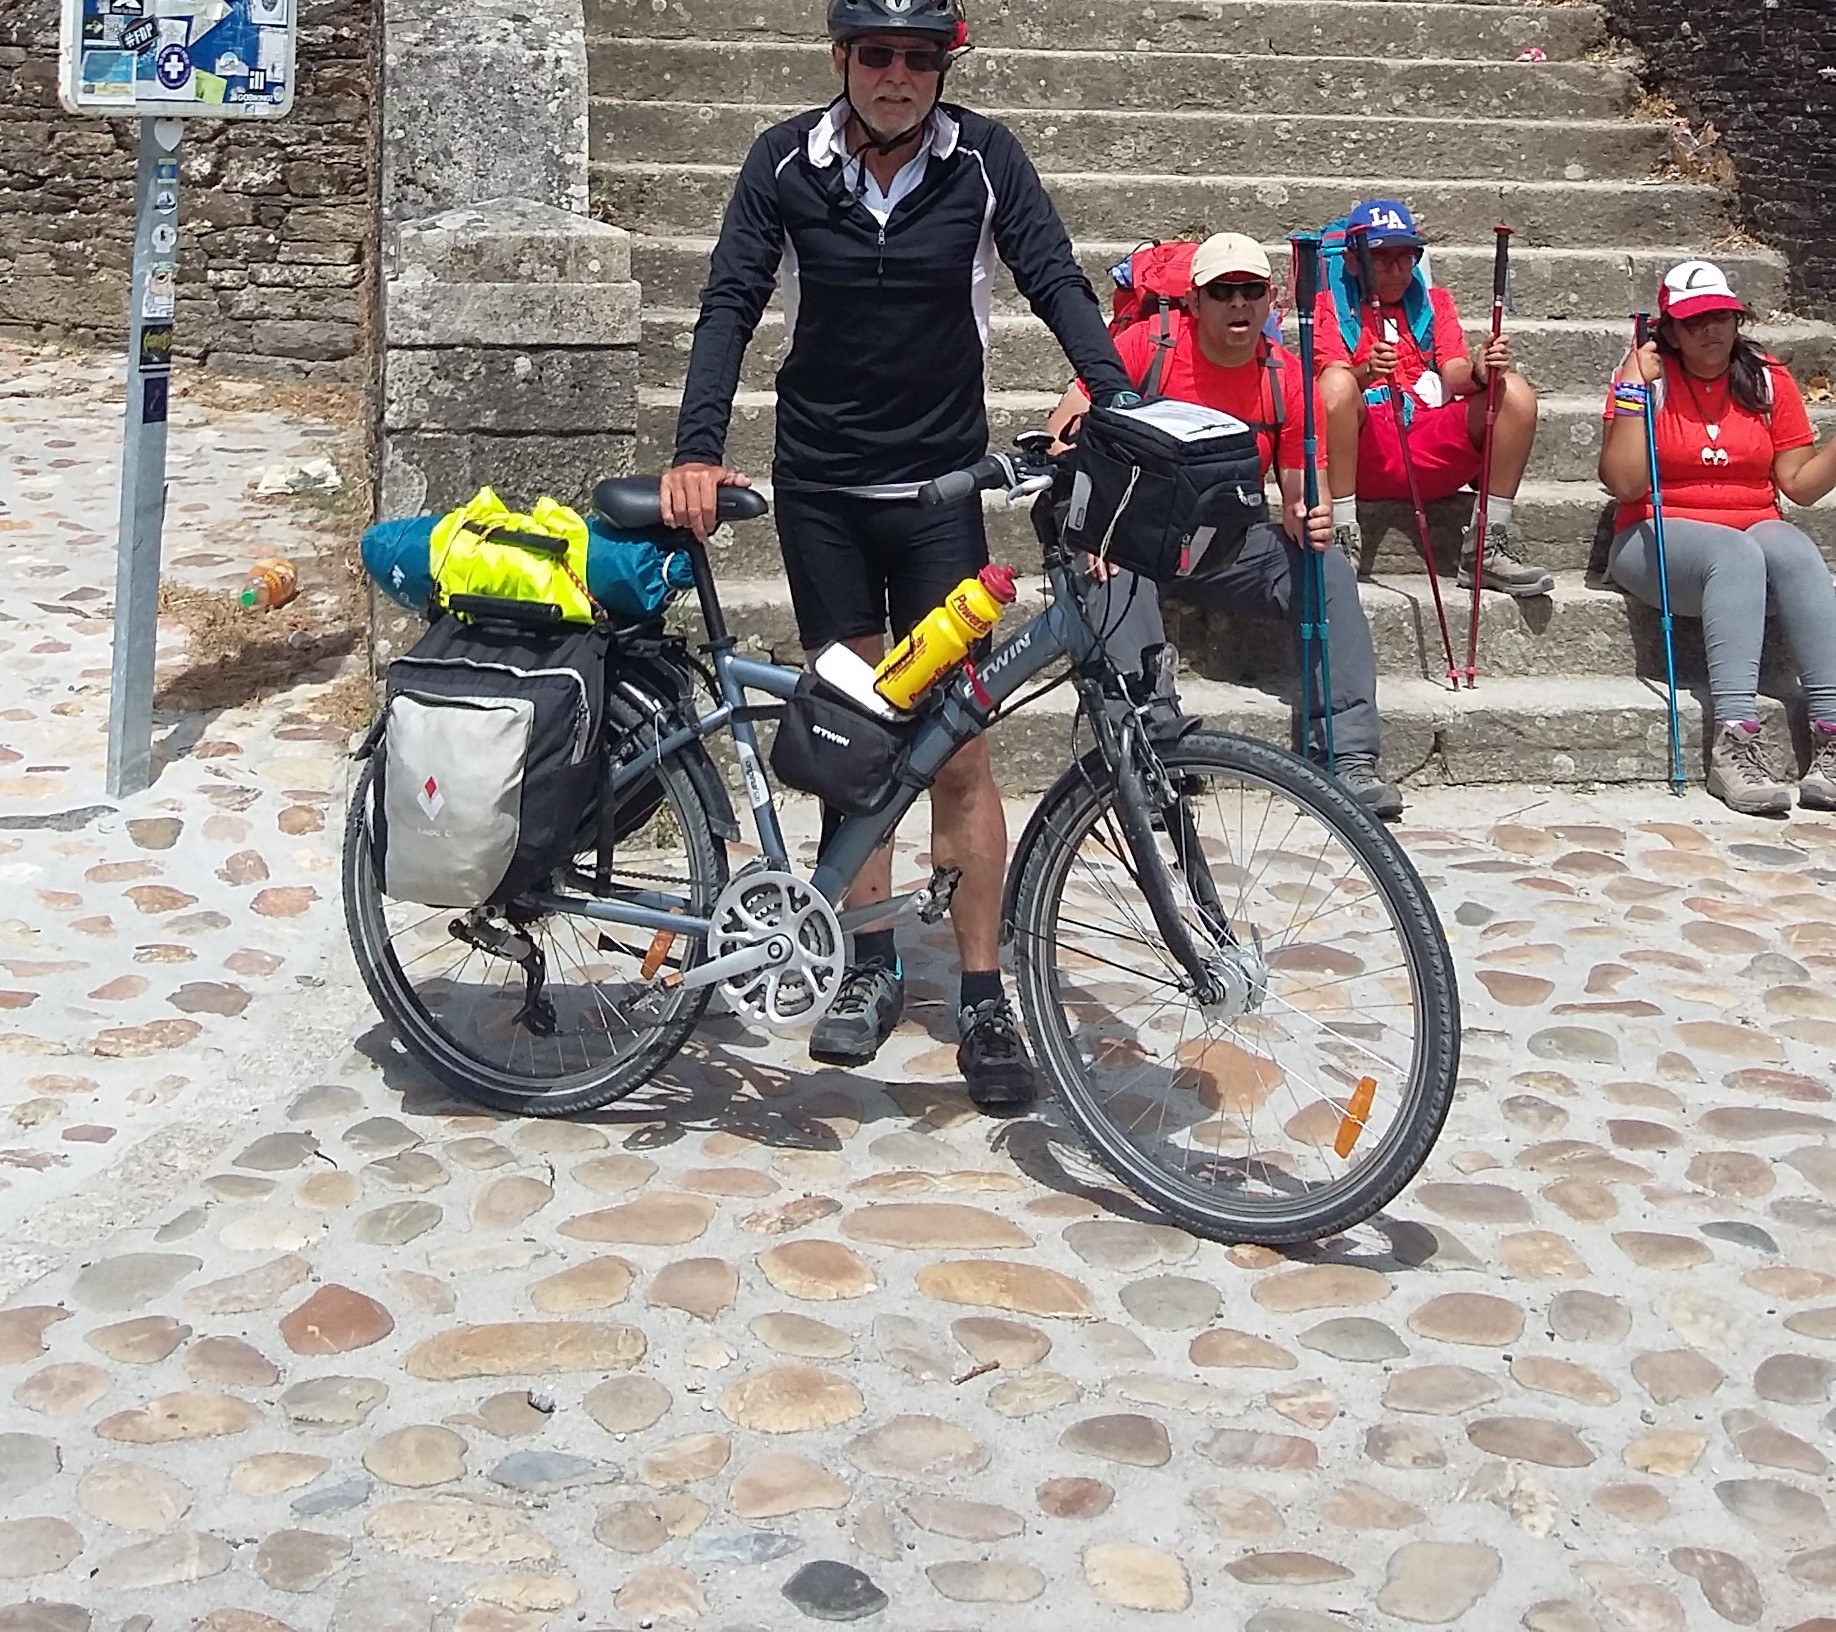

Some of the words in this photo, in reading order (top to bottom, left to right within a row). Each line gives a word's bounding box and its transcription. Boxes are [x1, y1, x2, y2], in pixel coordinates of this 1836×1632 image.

[124, 22, 153, 48] #FDP
[1369, 207, 1407, 230] LA
[812, 724, 850, 747] BTWIN
